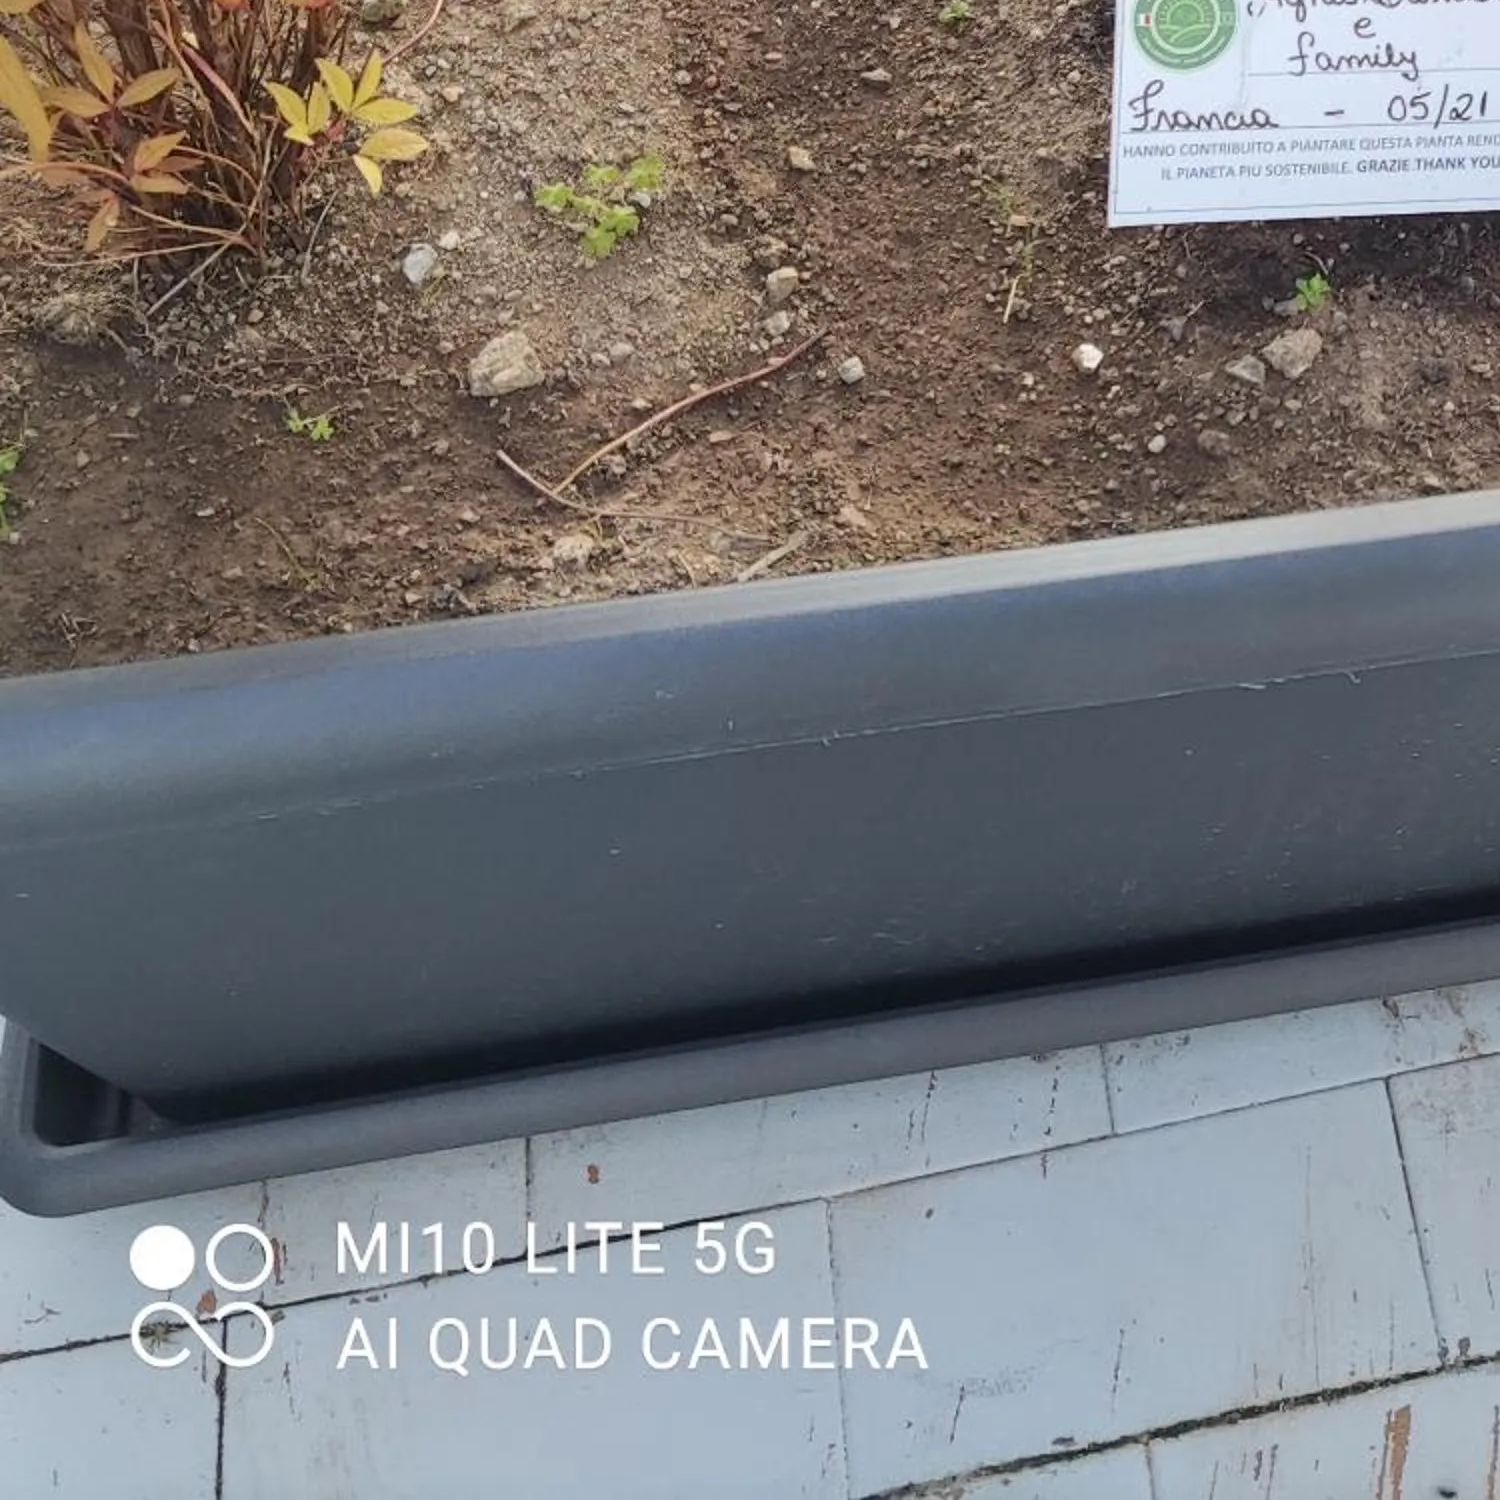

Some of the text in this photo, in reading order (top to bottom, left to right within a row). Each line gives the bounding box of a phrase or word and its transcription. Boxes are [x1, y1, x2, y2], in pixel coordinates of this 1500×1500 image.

[1353, 16, 1377, 38] e
[1128, 79, 1279, 131] Francia
[1386, 84, 1489, 129] 05/21
[1122, 145, 1176, 158] HANNO
[1179, 140, 1274, 156] CONTRIBUITO
[1276, 140, 1287, 152] A
[1291, 138, 1356, 153] PIANTARE
[1359, 136, 1413, 151] QUESTA
[1415, 134, 1464, 149] PIANTA
[1161, 167, 1172, 181] IL
[1177, 164, 1236, 180] PIANETA
[1414, 156, 1466, 171] THANK
